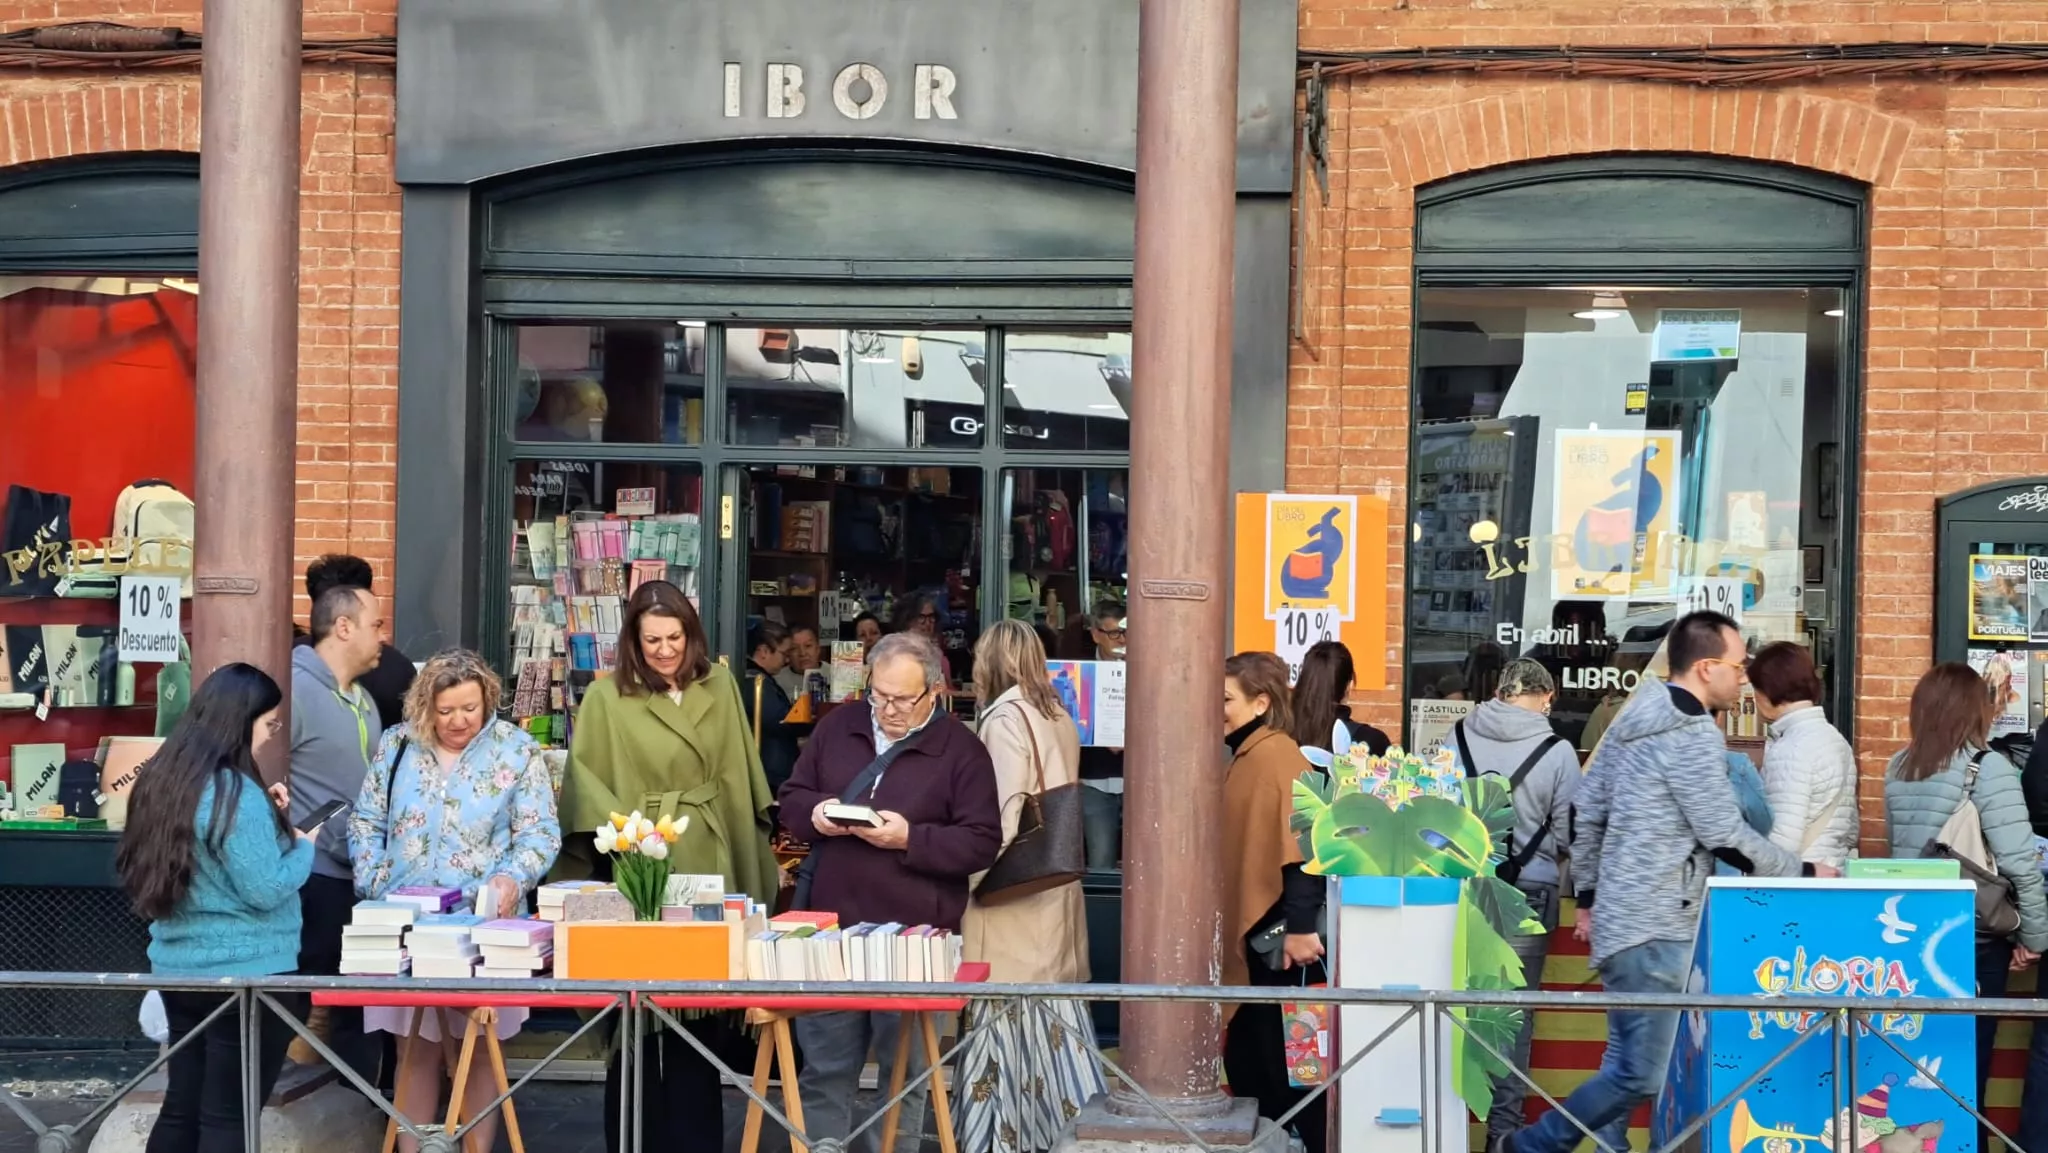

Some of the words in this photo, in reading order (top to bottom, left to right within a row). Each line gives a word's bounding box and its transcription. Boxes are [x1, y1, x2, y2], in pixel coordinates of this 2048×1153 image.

[724, 62, 957, 119] IBOR
[2030, 558, 2048, 570] Qu
[129, 584, 150, 617] 10
[157, 585, 173, 619] %
[121, 628, 177, 652] Descuento
[1284, 611, 1308, 645] 10
[1315, 612, 1332, 642] %
[1496, 622, 1524, 645] En
[1531, 623, 1580, 646] abril
[1978, 625, 2027, 635] PORTUGAL
[18, 642, 42, 682] MILAN
[55, 643, 78, 680] MILAN
[1423, 705, 1468, 714] CASTILLO
[26, 762, 57, 801] MILAN
[1753, 946, 1917, 995] GLORIA
